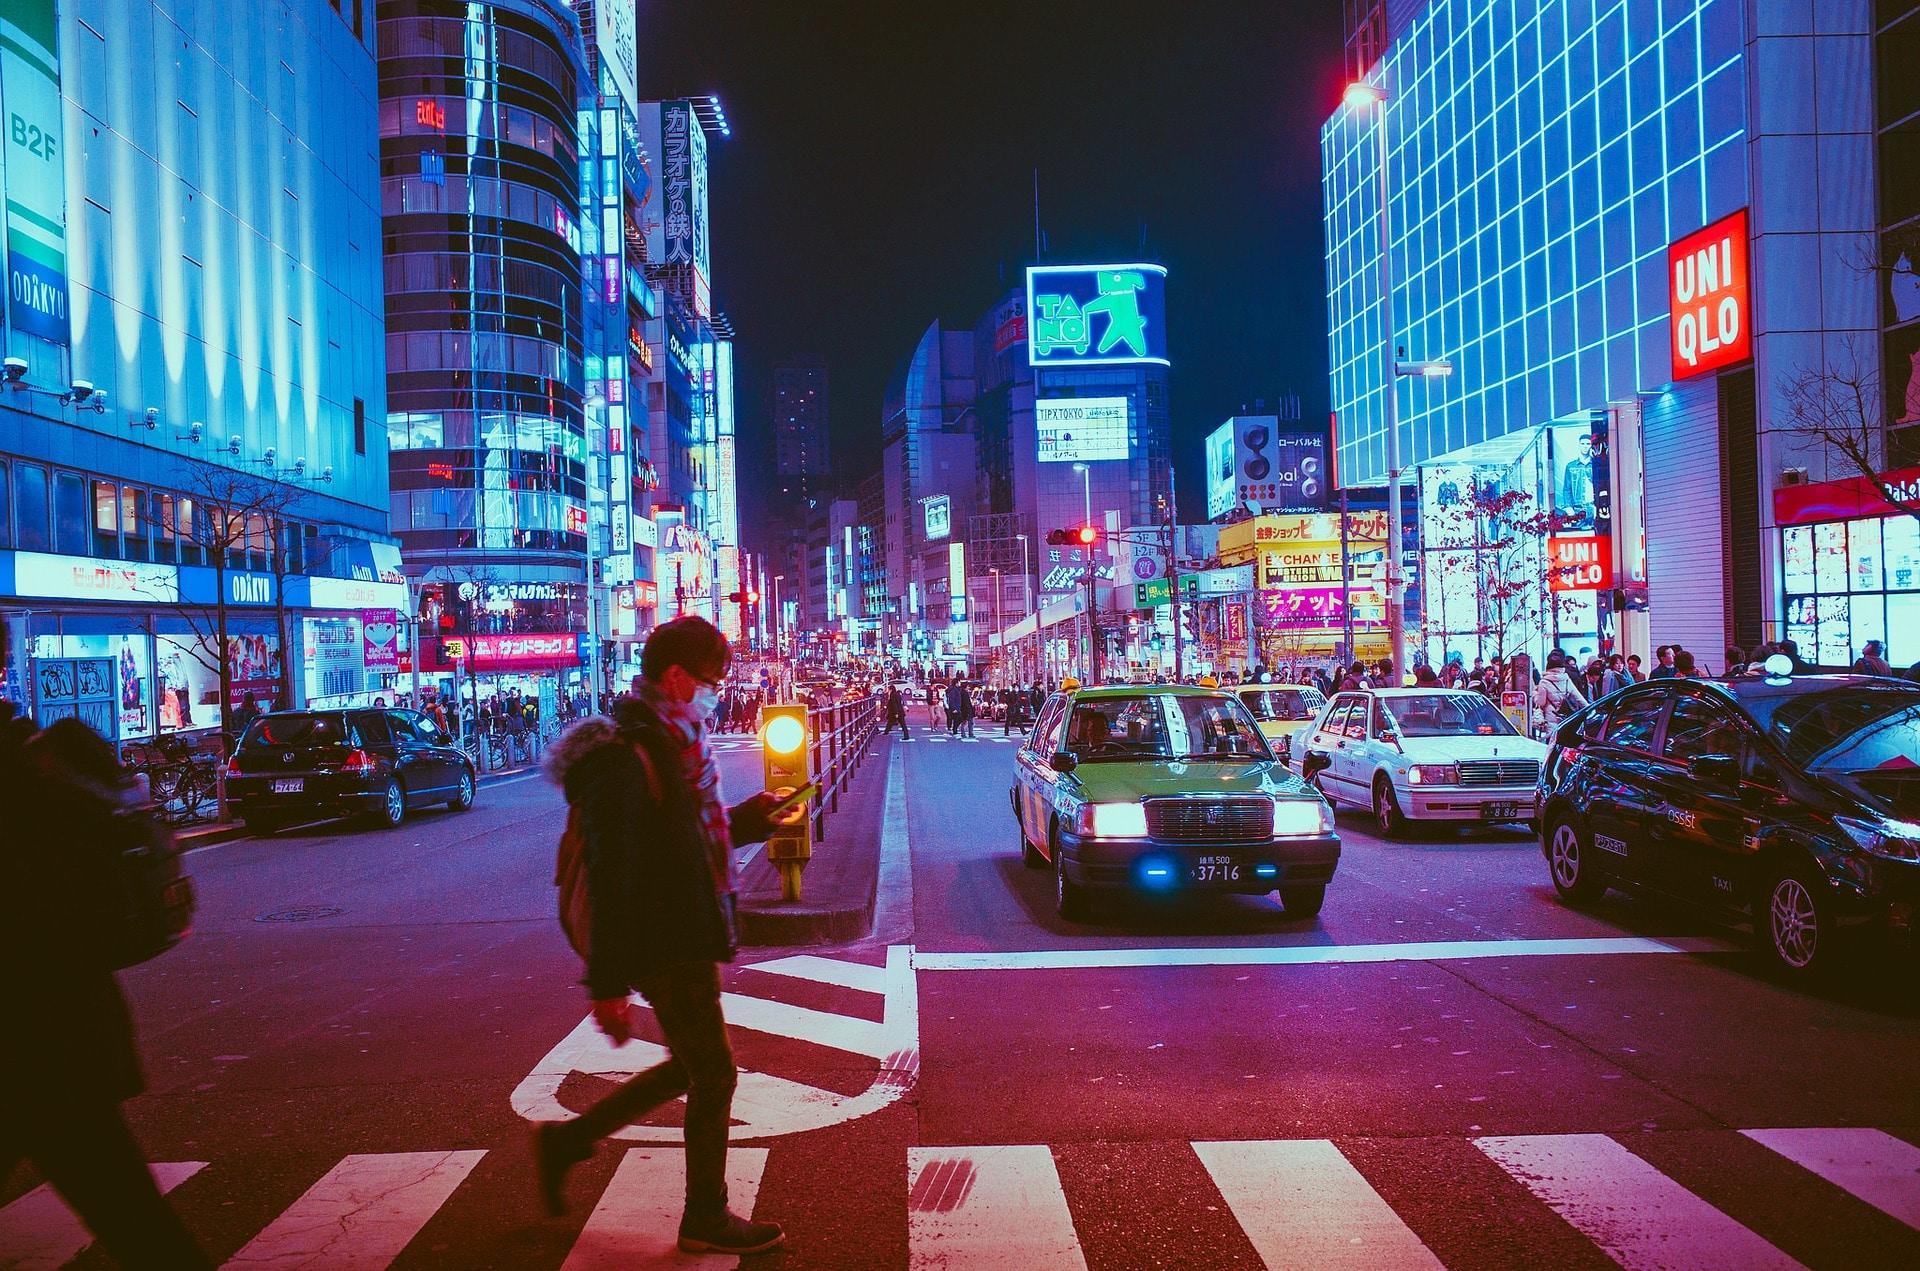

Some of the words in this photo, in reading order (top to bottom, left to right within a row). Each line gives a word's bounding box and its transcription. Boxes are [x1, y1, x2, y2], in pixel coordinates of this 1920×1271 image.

[11, 112, 56, 162] B2F
[663, 107, 692, 264] カラオケの鉄人
[1676, 238, 1731, 304] UNI
[1678, 296, 1739, 366] QLO
[1265, 553, 1340, 566] ECHANE
[1560, 543, 1598, 561] UNI
[1282, 574, 1316, 582] UNION
[1560, 565, 1602, 587] QLO
[1266, 591, 1343, 612] チケット
[499, 639, 562, 656] サンドラッグ
[1216, 856, 1230, 864] 500
[1198, 865, 1240, 880] 37-16
[1712, 876, 1733, 892] TAXI
